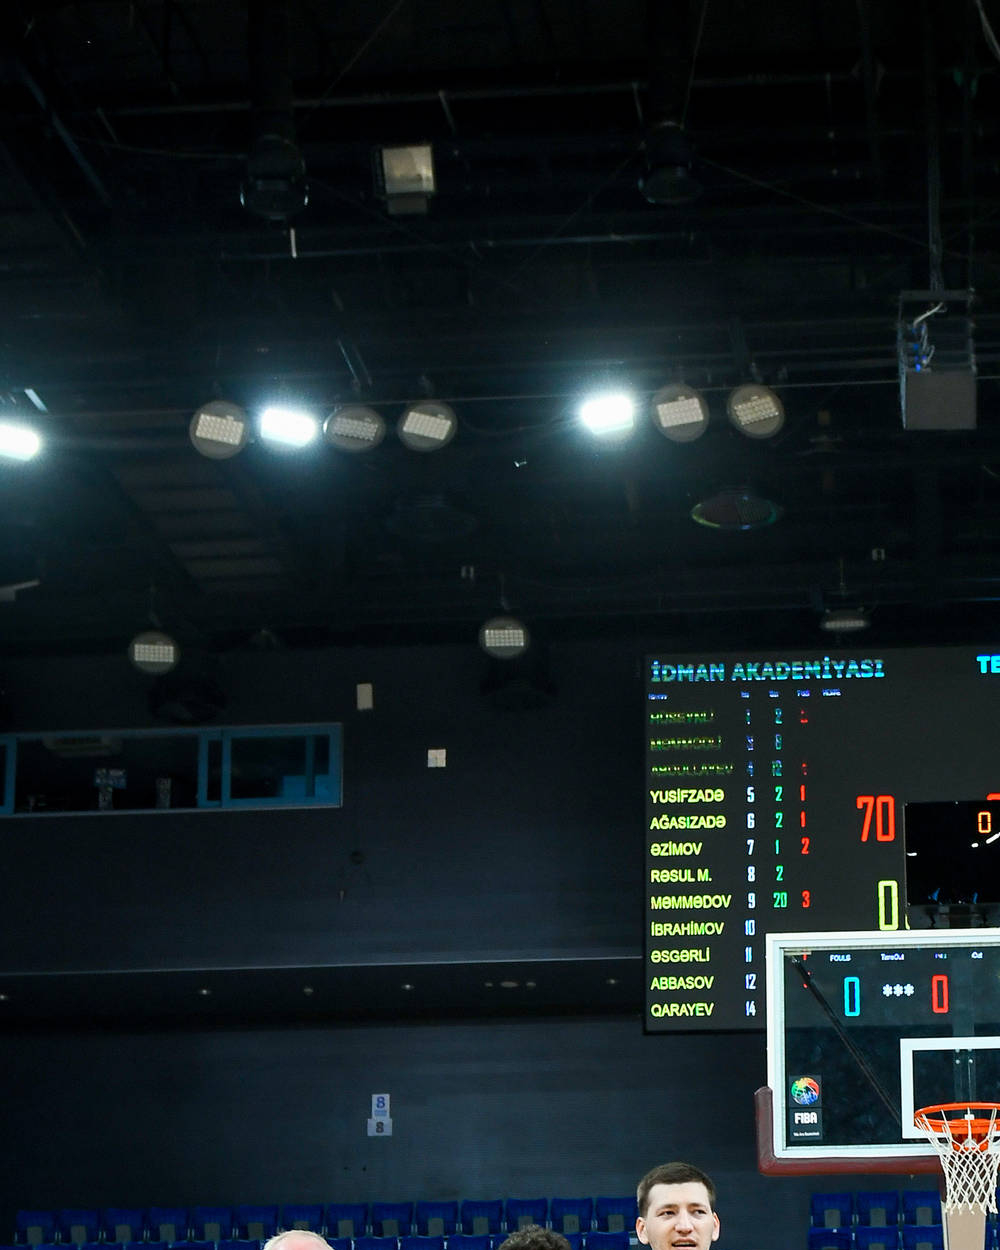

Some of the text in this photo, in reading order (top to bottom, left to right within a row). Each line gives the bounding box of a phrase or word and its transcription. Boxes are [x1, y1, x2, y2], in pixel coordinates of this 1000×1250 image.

[651, 656, 884, 682] İDMAN AKADEMİYASI
[650, 785, 805, 803] YUSİFZADƏ 5 2 1
[747, 813, 754, 828] 6
[776, 812, 782, 827] 2
[801, 811, 805, 827] 1
[856, 795, 895, 842] 70
[977, 811, 992, 834] 0
[651, 837, 809, 856] ƏZİMOV 7 1 2
[651, 865, 783, 882] RƏSUL M. 8 2
[651, 890, 810, 909] MƏMMƏDOV 9 20 3
[651, 920, 755, 936] İBRAHİMOV 10
[651, 947, 752, 963] ƏSGƏRLİ 11
[651, 974, 756, 990] ABBASOV 12
[844, 977, 860, 1016] 0
[932, 975, 948, 1013] 0
[651, 1001, 756, 1017] QARAYEV 14
[376, 1096, 386, 1109] 8
[794, 1112, 818, 1125] FIBA
[375, 1121, 385, 1134] 8
